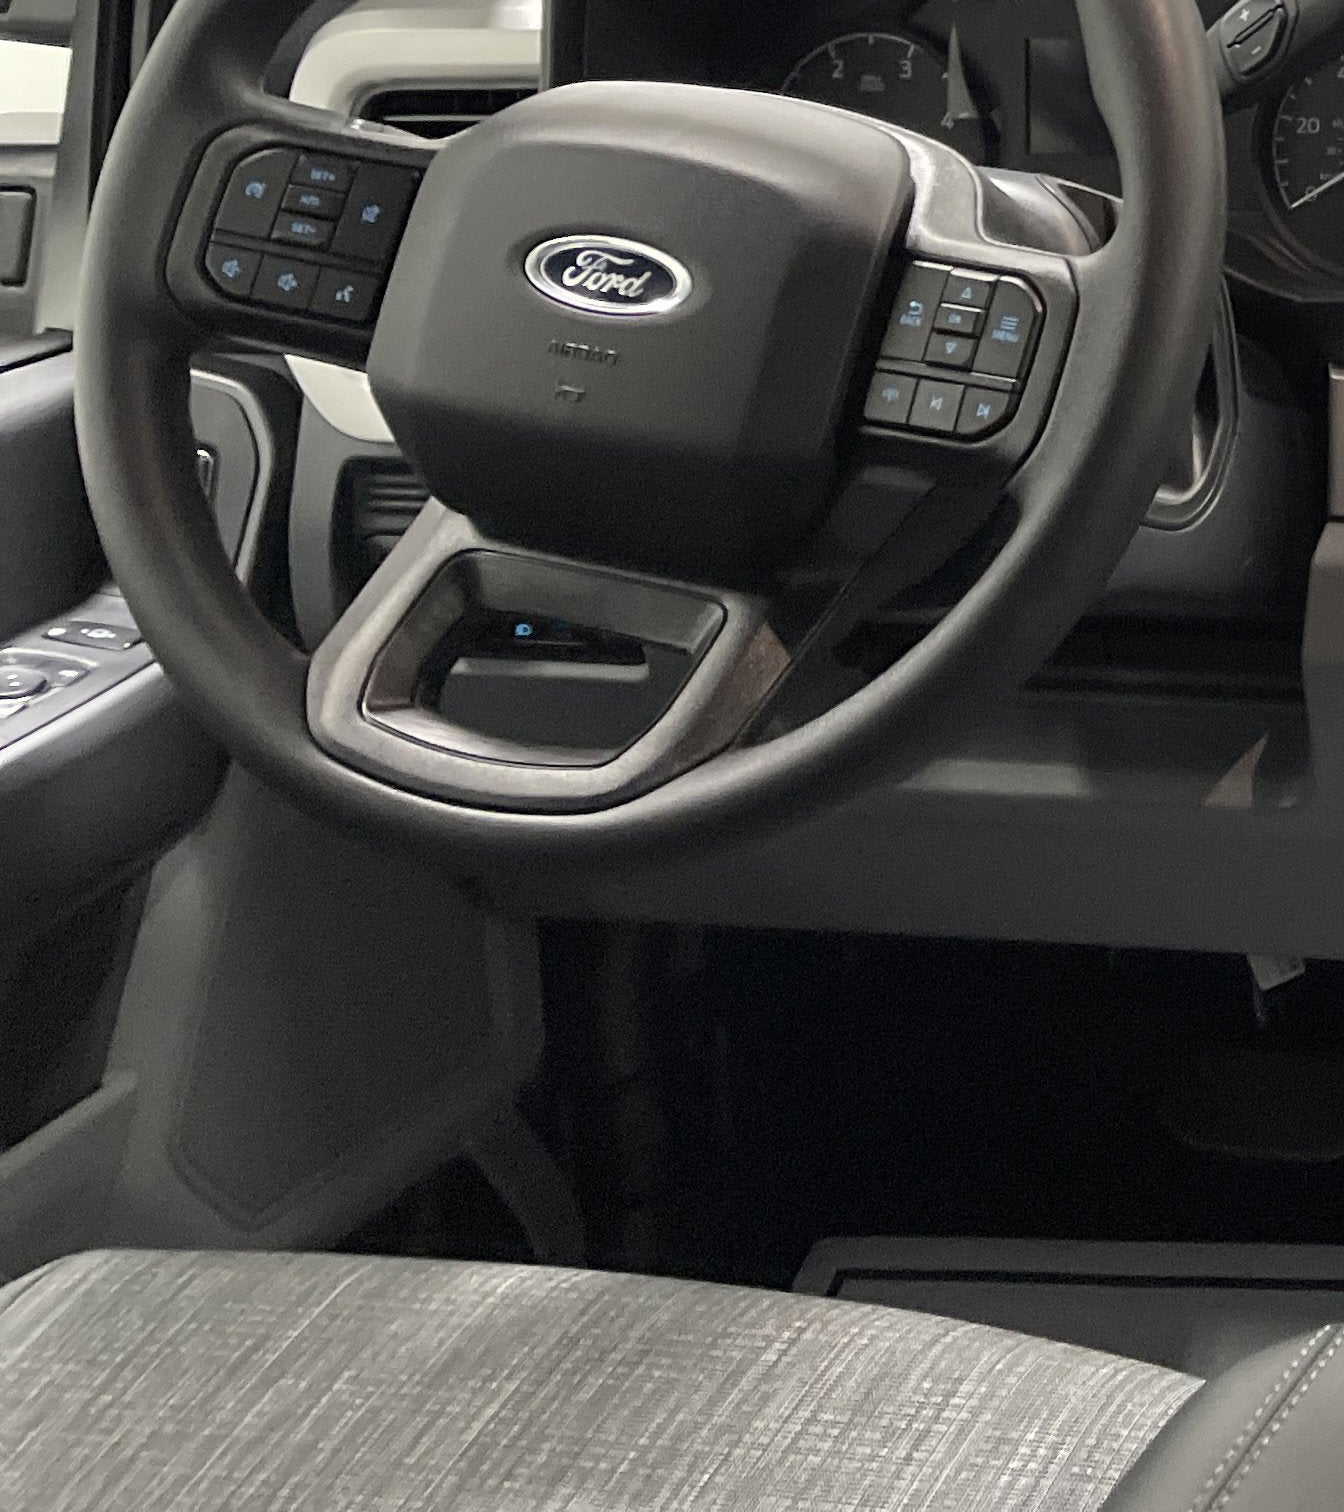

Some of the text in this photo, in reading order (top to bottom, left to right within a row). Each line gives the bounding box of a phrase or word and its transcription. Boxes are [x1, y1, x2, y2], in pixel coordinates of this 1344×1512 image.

[831, 60, 844, 79] 2
[899, 60, 912, 79] 3
[940, 112, 954, 129] 4
[1296, 118, 1320, 134] 20
[562, 249, 652, 298] Ford
